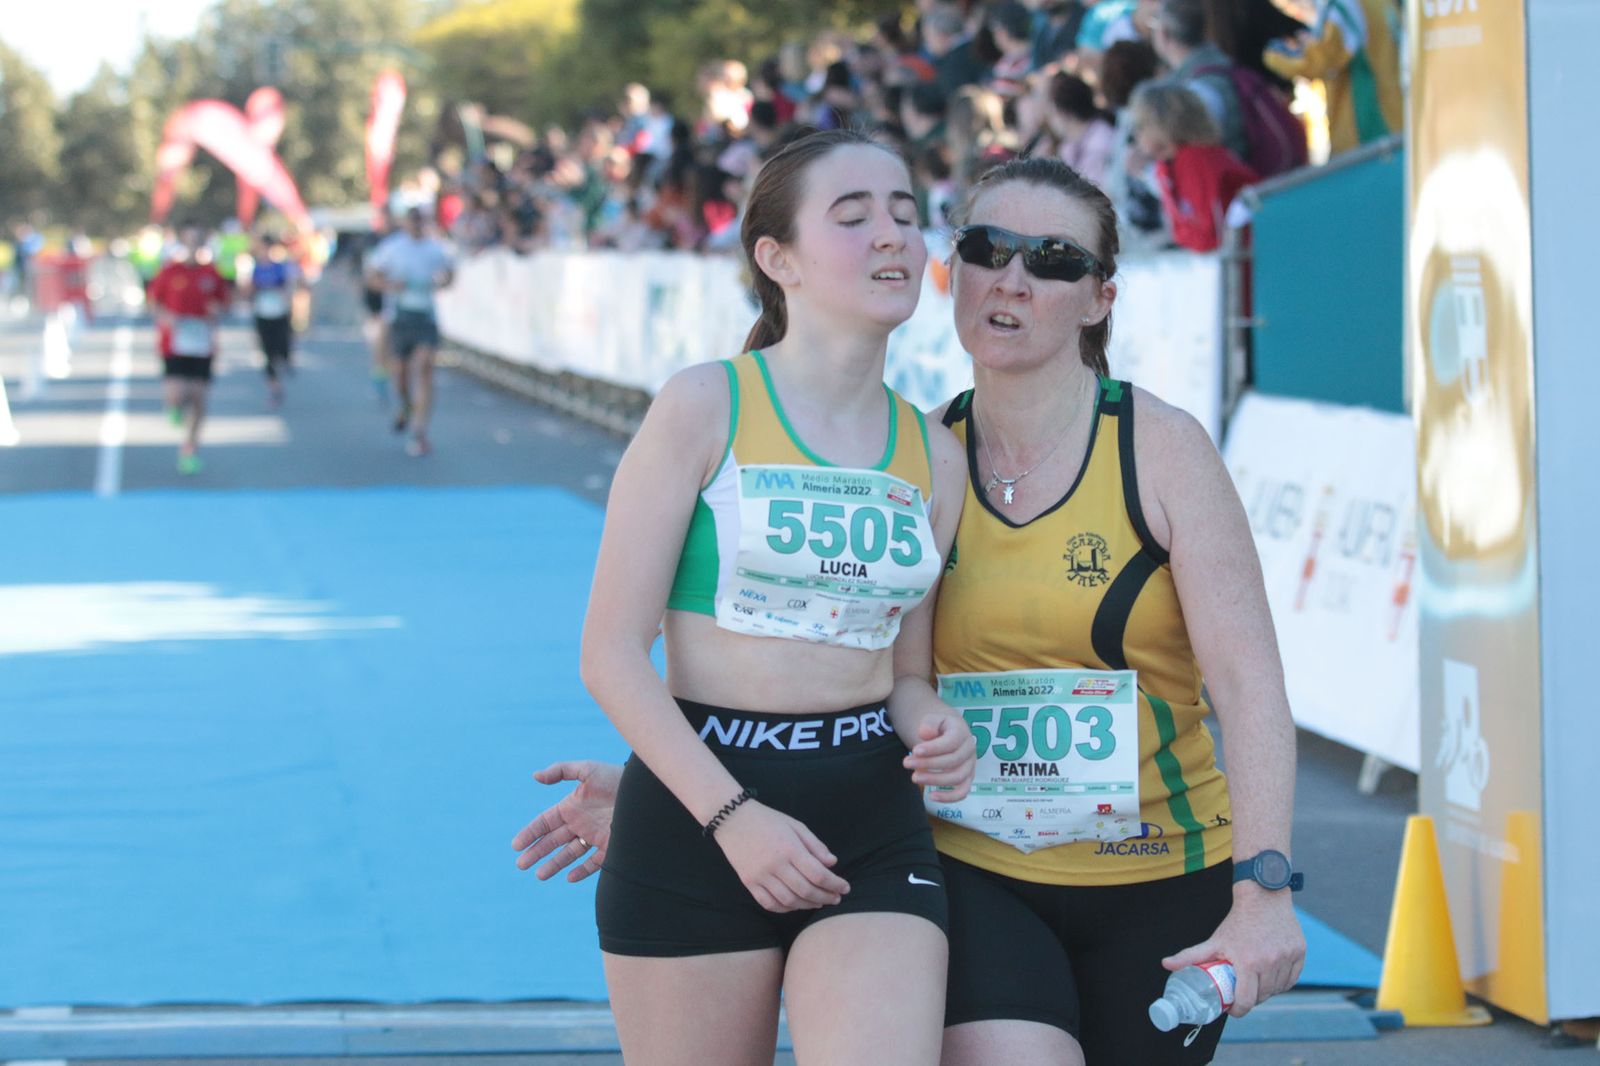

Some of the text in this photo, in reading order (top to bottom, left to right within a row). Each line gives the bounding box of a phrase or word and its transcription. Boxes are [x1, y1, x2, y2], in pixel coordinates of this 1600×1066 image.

[801, 473, 873, 486] Medio Maratón
[844, 485, 872, 496] 2022
[766, 499, 923, 567] 5505
[820, 560, 868, 578] LUCIA
[739, 588, 768, 603] NEXA
[787, 598, 810, 609] CDX
[990, 677, 1055, 687] Medio Maratón
[1028, 685, 1054, 695] 2022
[700, 715, 824, 751] NIKE
[963, 705, 1117, 761] 5503
[1000, 762, 1060, 777] FATIMA
[937, 808, 962, 819] NEXA
[982, 807, 1003, 819] CDX
[1094, 841, 1170, 856] JACARSA
